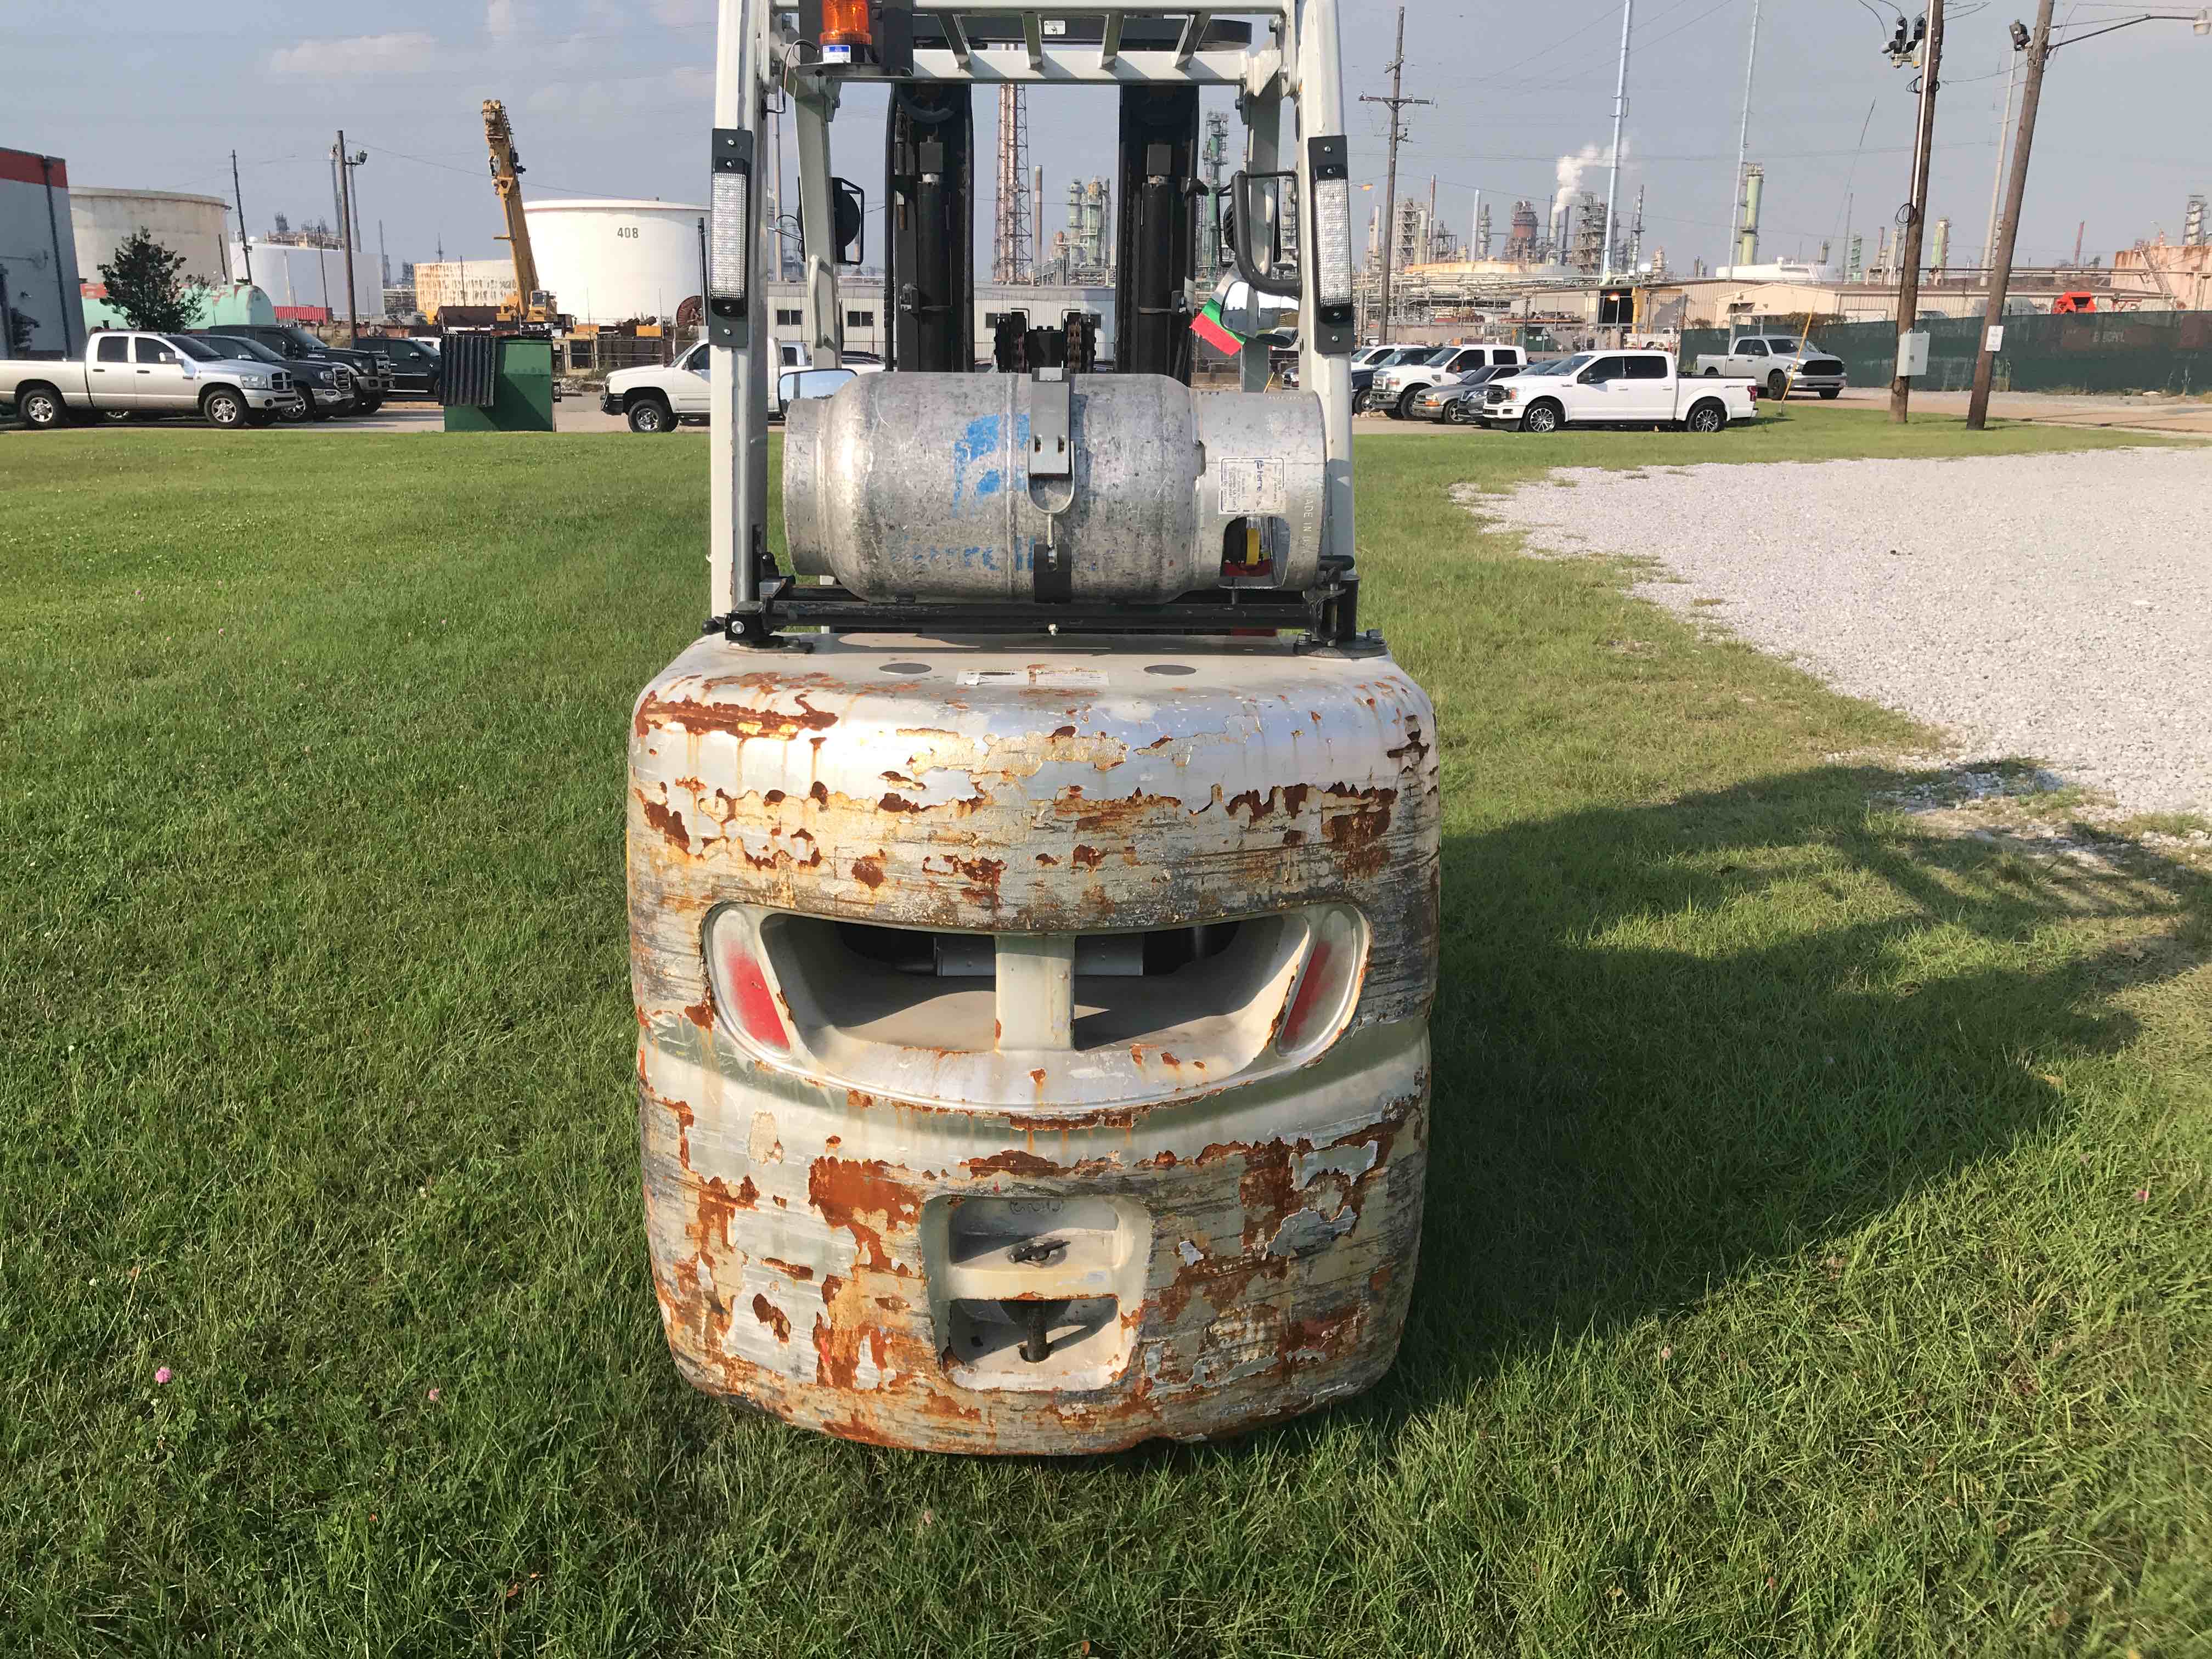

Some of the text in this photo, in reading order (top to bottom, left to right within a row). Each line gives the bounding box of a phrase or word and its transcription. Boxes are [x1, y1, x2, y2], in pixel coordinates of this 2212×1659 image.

[617, 227, 639, 238] 408
[1303, 490, 1314, 518] MADE
[1303, 522, 1312, 532] IN
